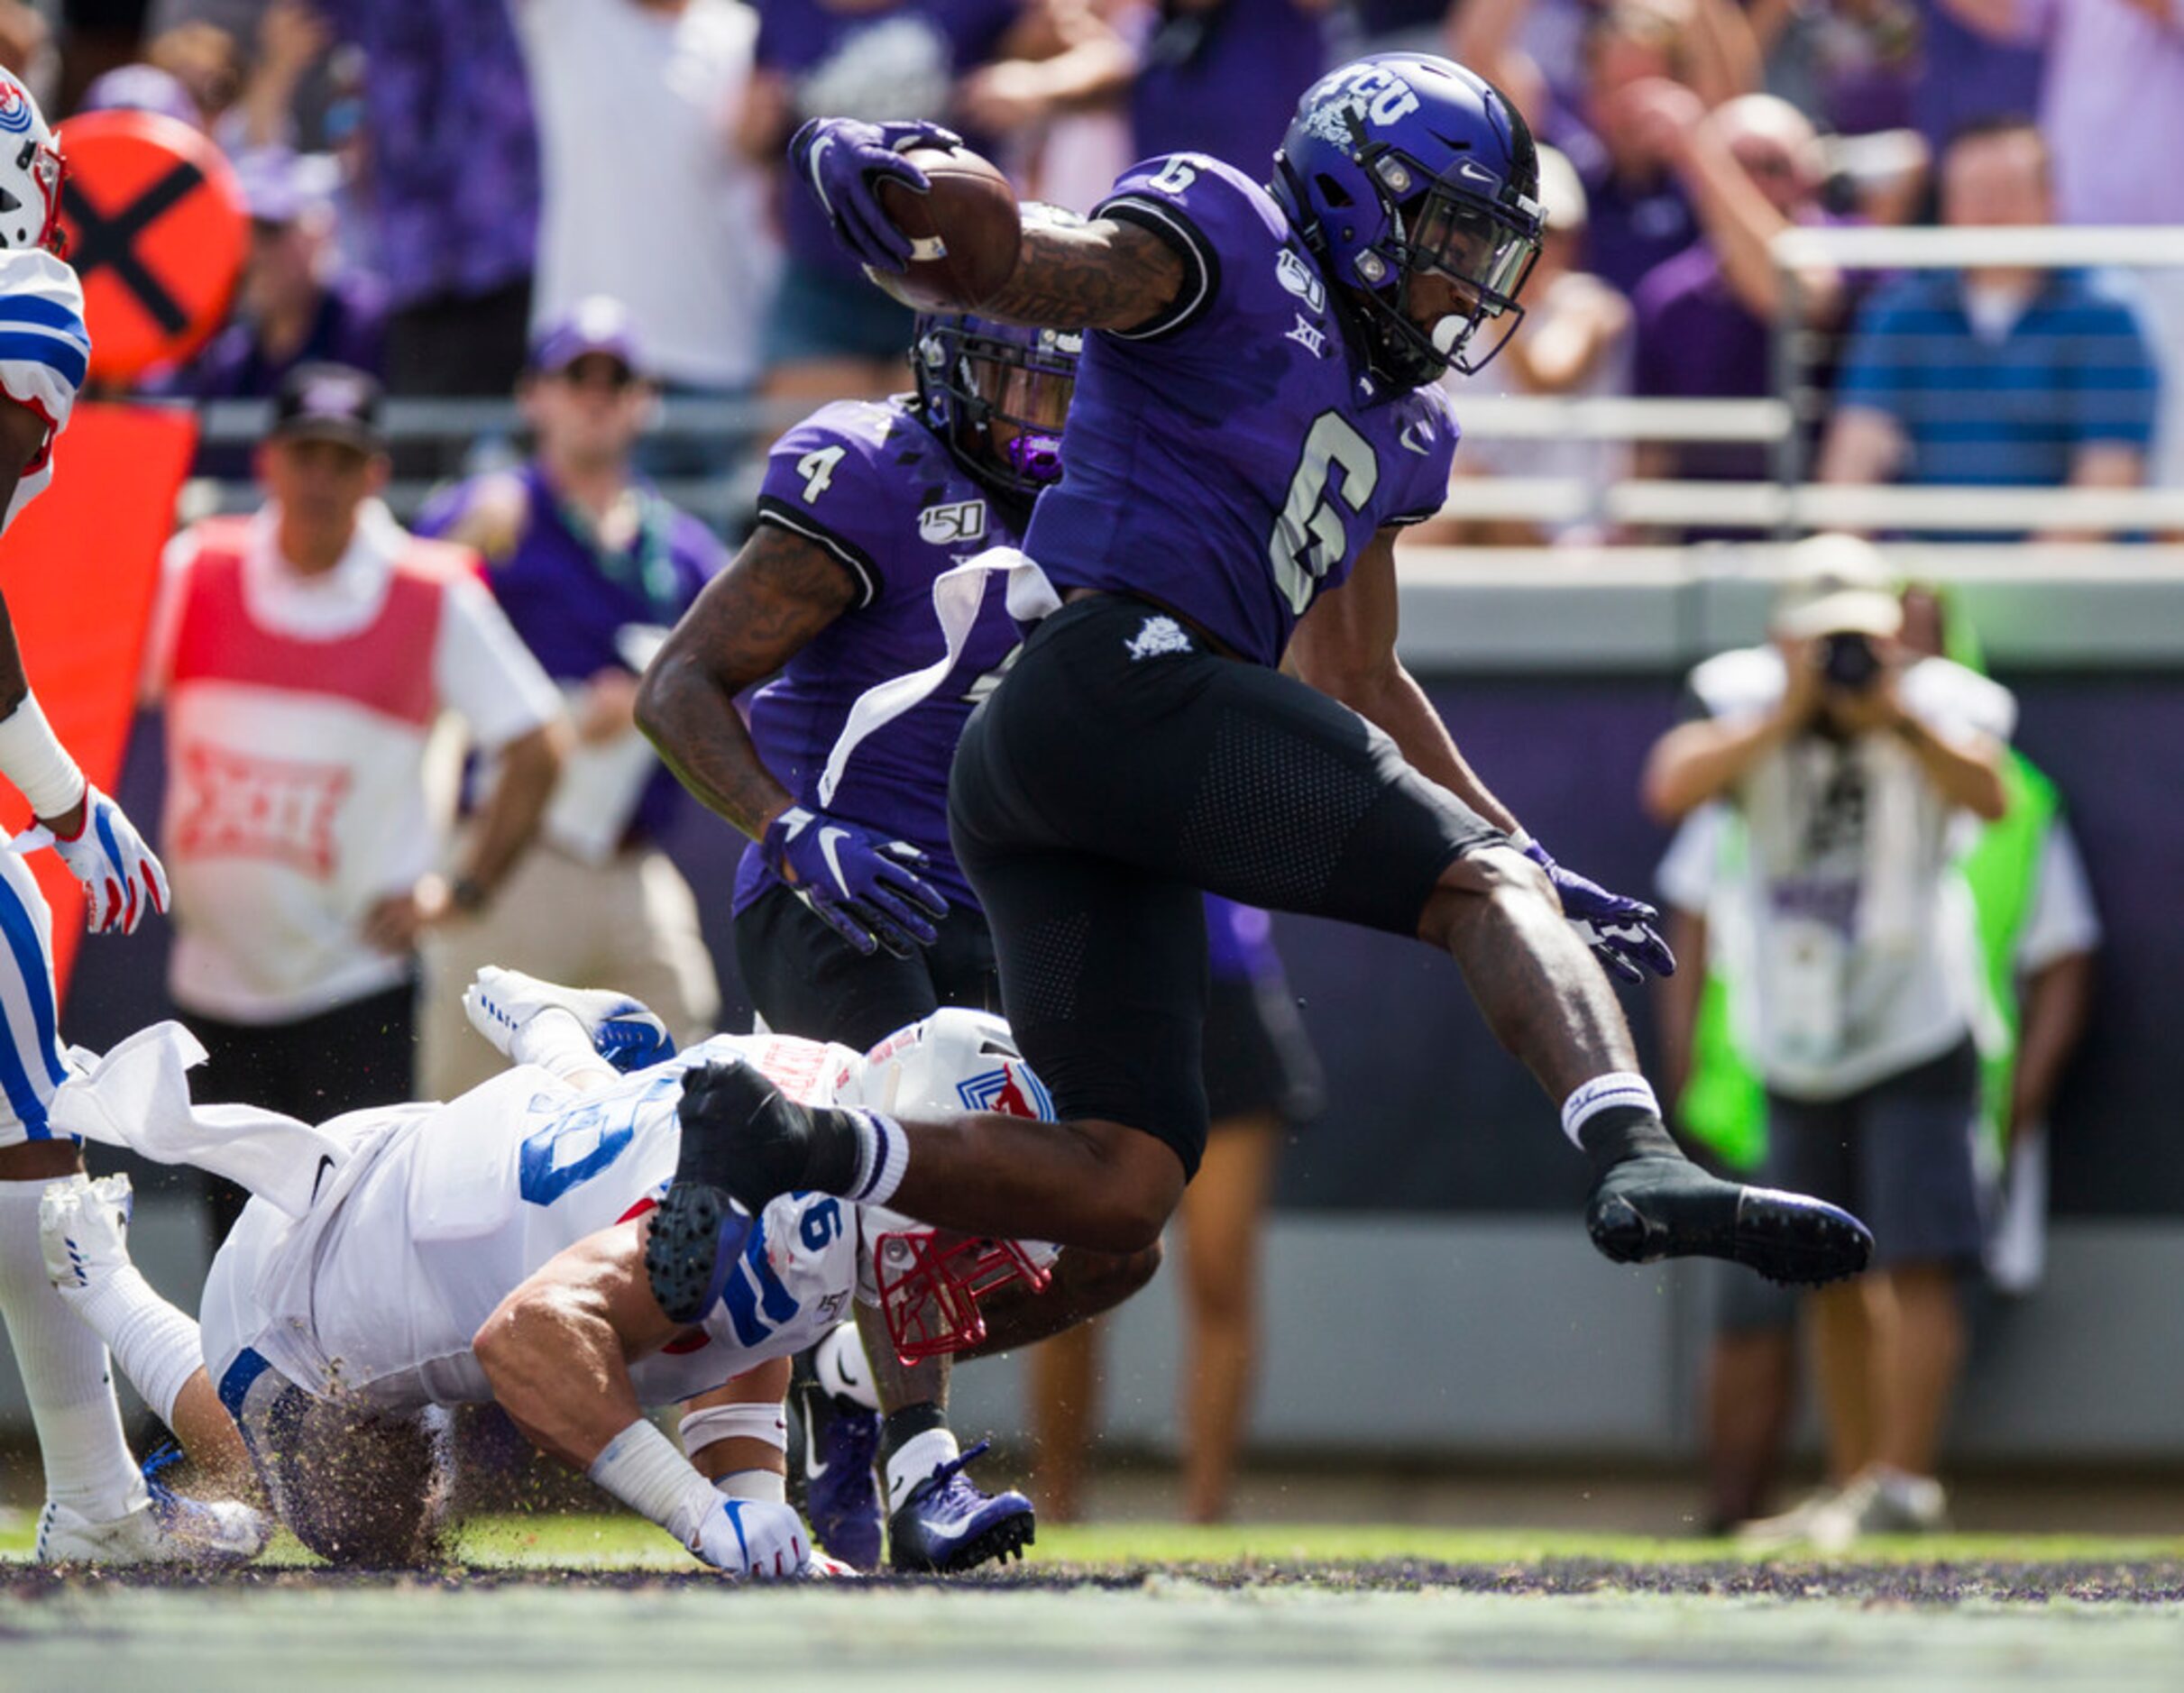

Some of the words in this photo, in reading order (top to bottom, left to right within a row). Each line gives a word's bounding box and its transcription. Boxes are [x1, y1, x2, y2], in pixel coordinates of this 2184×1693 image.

[1310, 63, 1420, 126] TCU
[1149, 156, 1205, 193] 6
[1275, 249, 1326, 314] 150
[796, 445, 846, 504] 4
[917, 499, 986, 545] 150
[1269, 409, 1379, 617] 6
